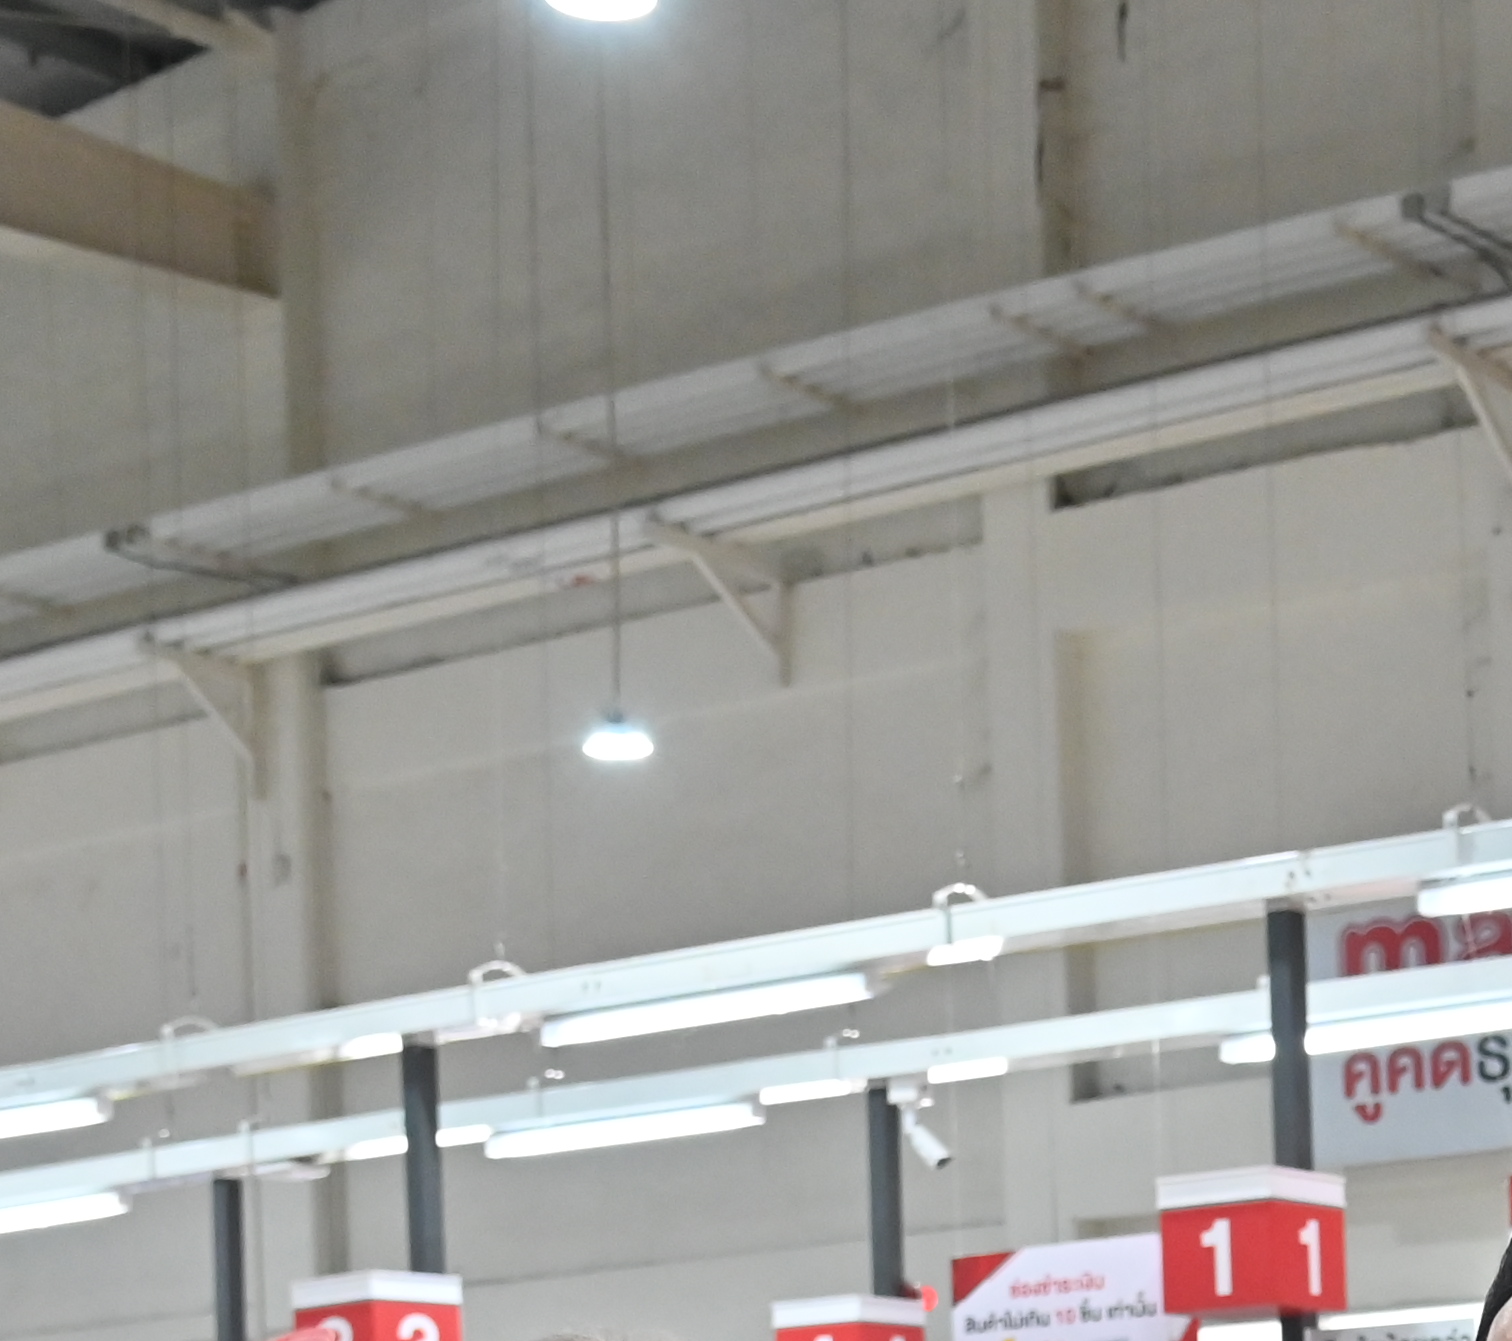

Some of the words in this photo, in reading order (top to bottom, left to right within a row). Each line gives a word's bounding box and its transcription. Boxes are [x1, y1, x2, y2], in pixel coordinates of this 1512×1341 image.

[1199, 1218, 1235, 1298] 1
[1297, 1218, 1323, 1298] 1
[1055, 1309, 1077, 1326] 10
